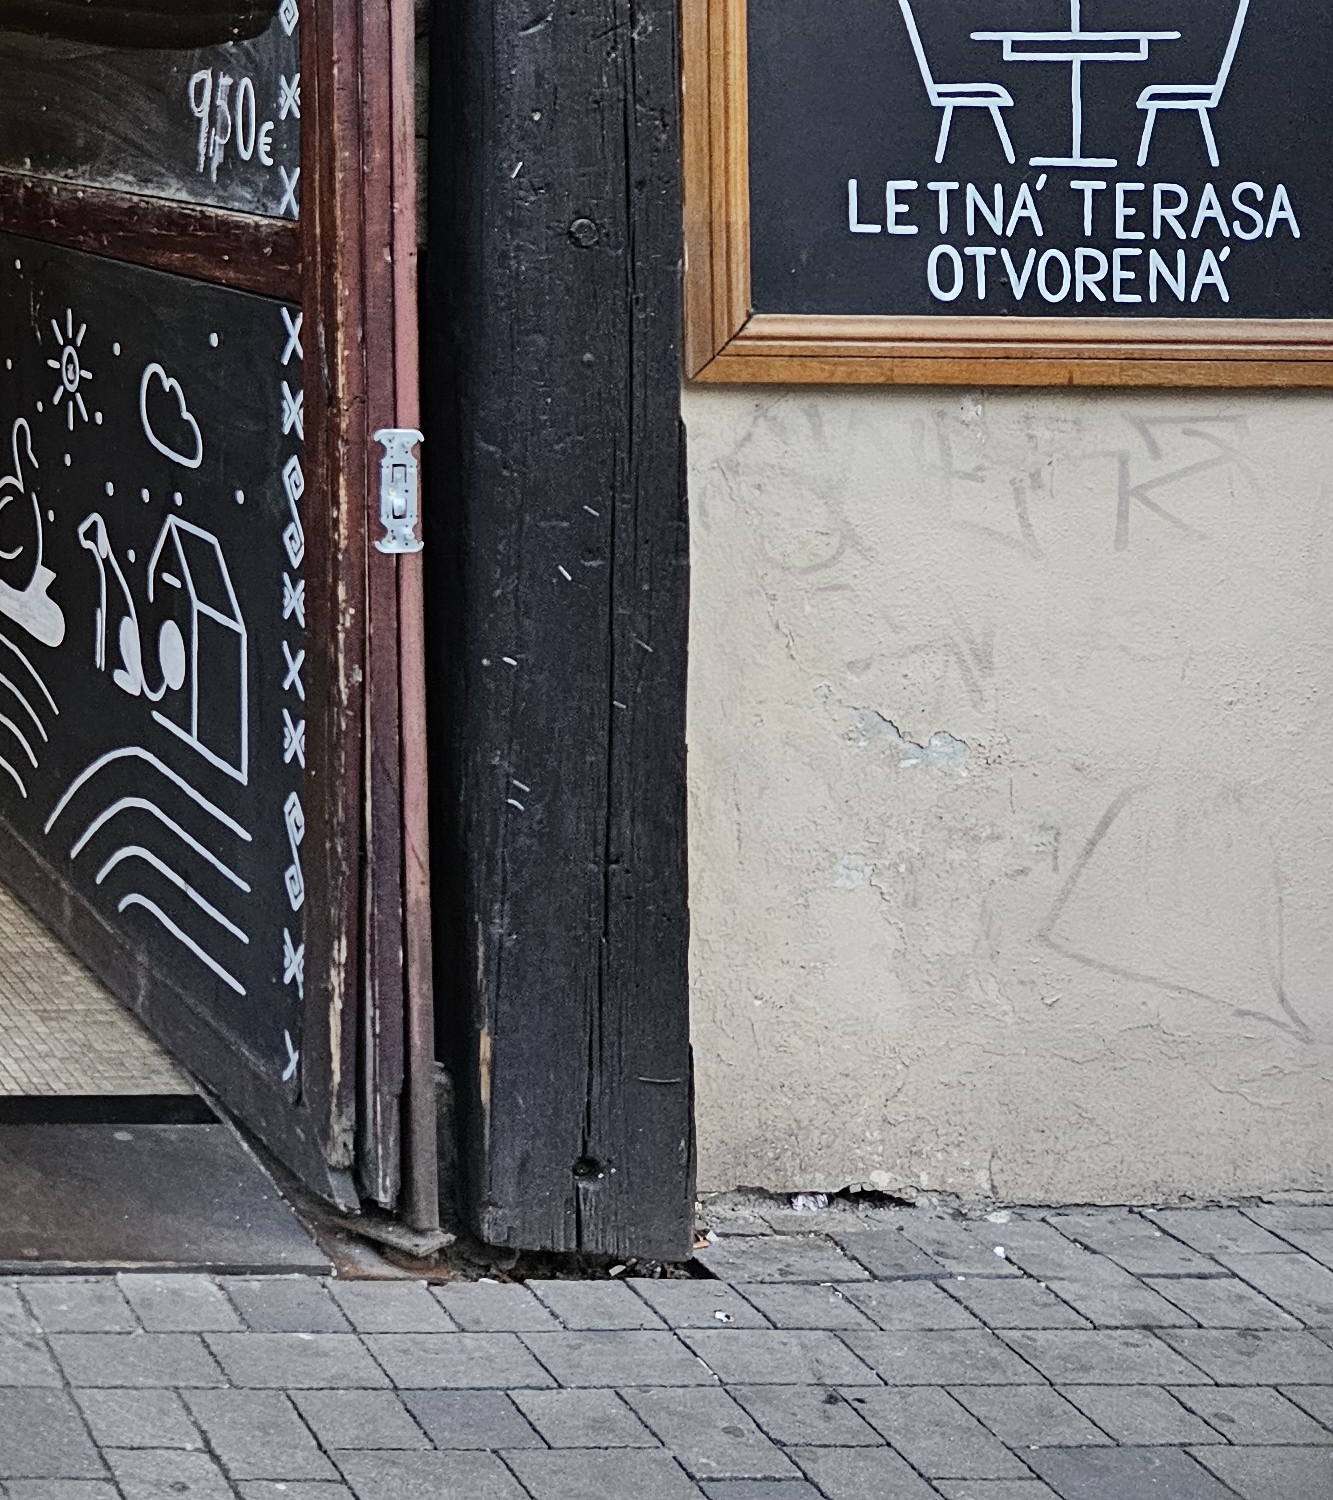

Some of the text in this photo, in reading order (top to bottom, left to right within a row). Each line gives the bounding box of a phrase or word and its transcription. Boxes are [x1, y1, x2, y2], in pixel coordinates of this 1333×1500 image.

[848, 174, 1301, 240] LETNÁ TERASA
[927, 244, 1231, 303] OTVORENÁ
